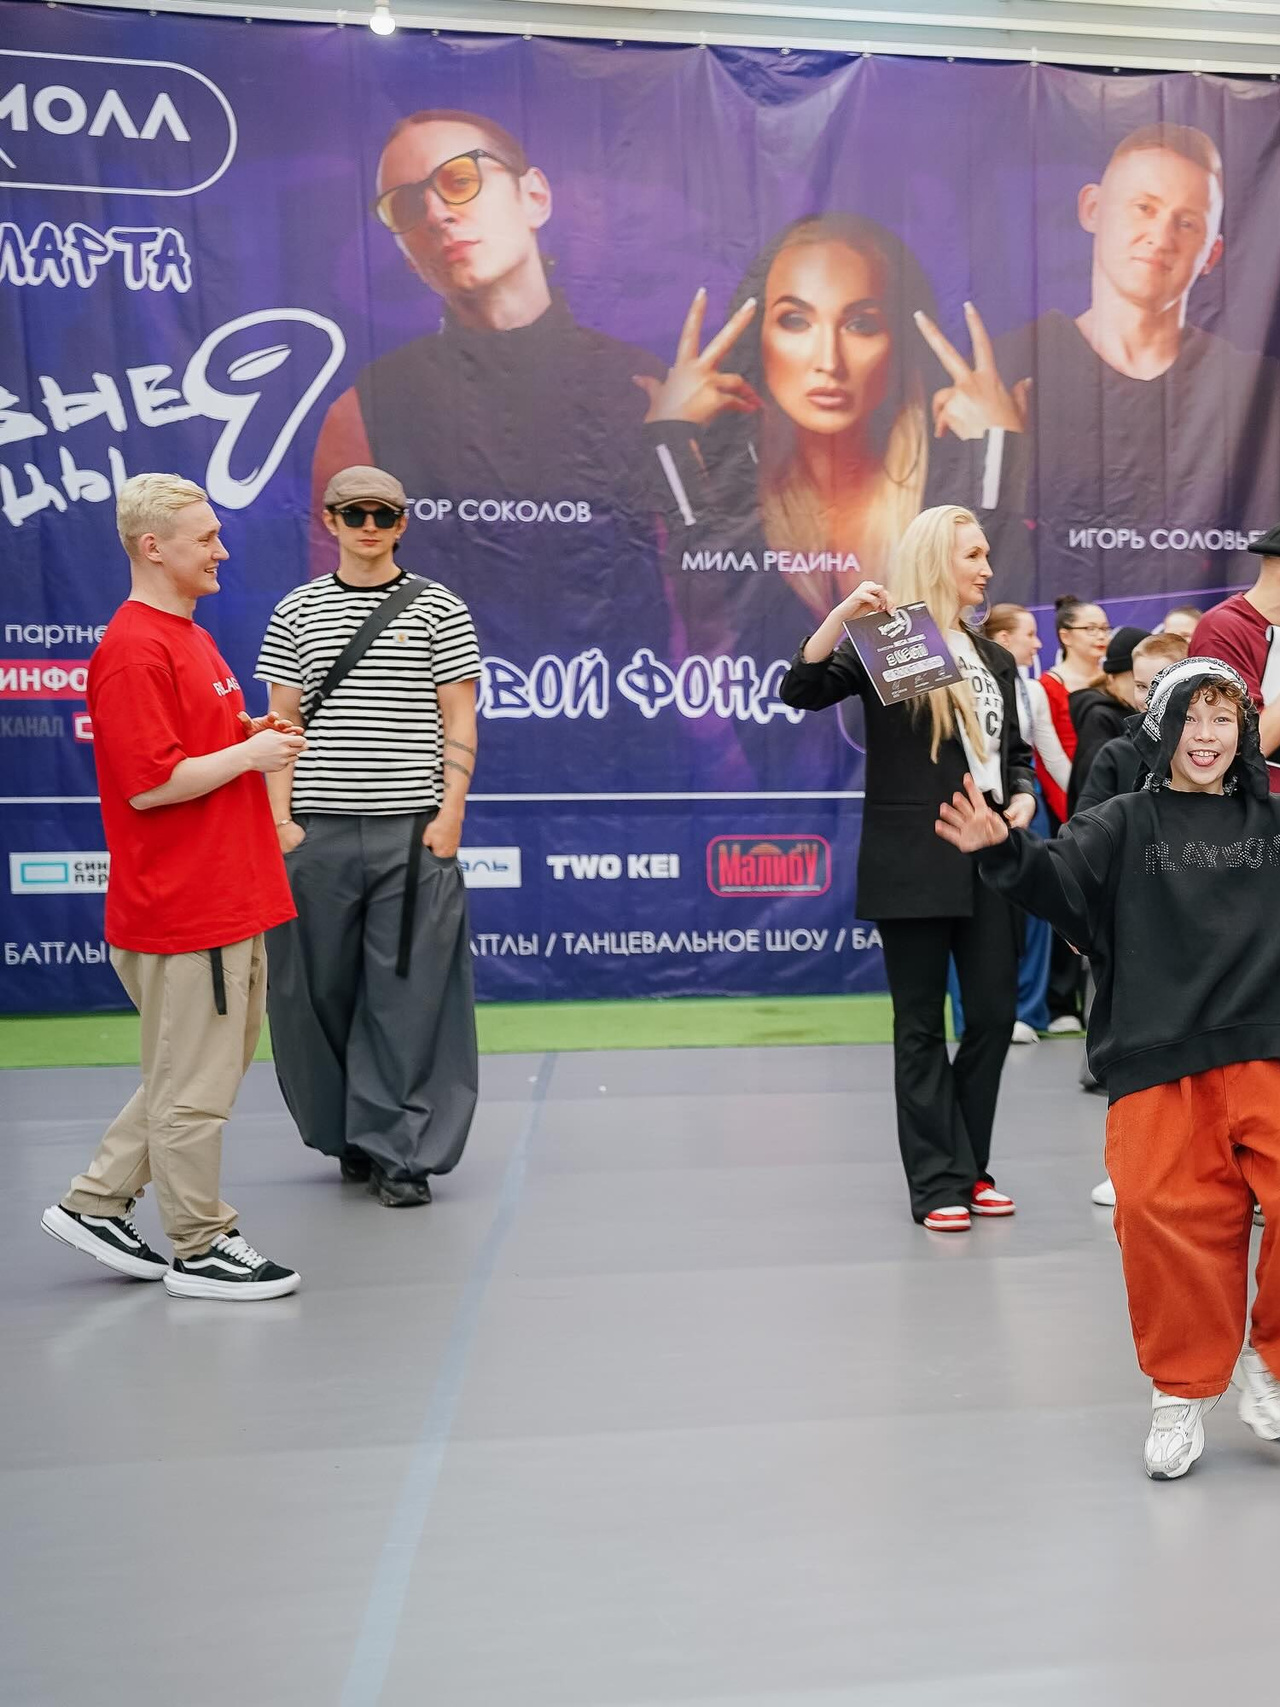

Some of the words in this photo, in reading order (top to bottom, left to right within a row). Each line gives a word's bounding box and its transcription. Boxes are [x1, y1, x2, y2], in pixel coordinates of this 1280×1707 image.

[457, 499, 593, 522] СОКОЛОВ
[1069, 528, 1146, 549] ИГОРЬ
[681, 550, 759, 571] МИЛА
[763, 550, 861, 574] РЕДИНА
[5, 624, 108, 649] партне
[475, 648, 610, 719] ВОЙ
[546, 854, 622, 880] TWO
[627, 854, 680, 879] KEI
[4, 941, 107, 965] БАТТЛЫ
[561, 929, 760, 957] ТАНЦЕВАЛЬНОЕ
[765, 927, 829, 952] ШОУ
